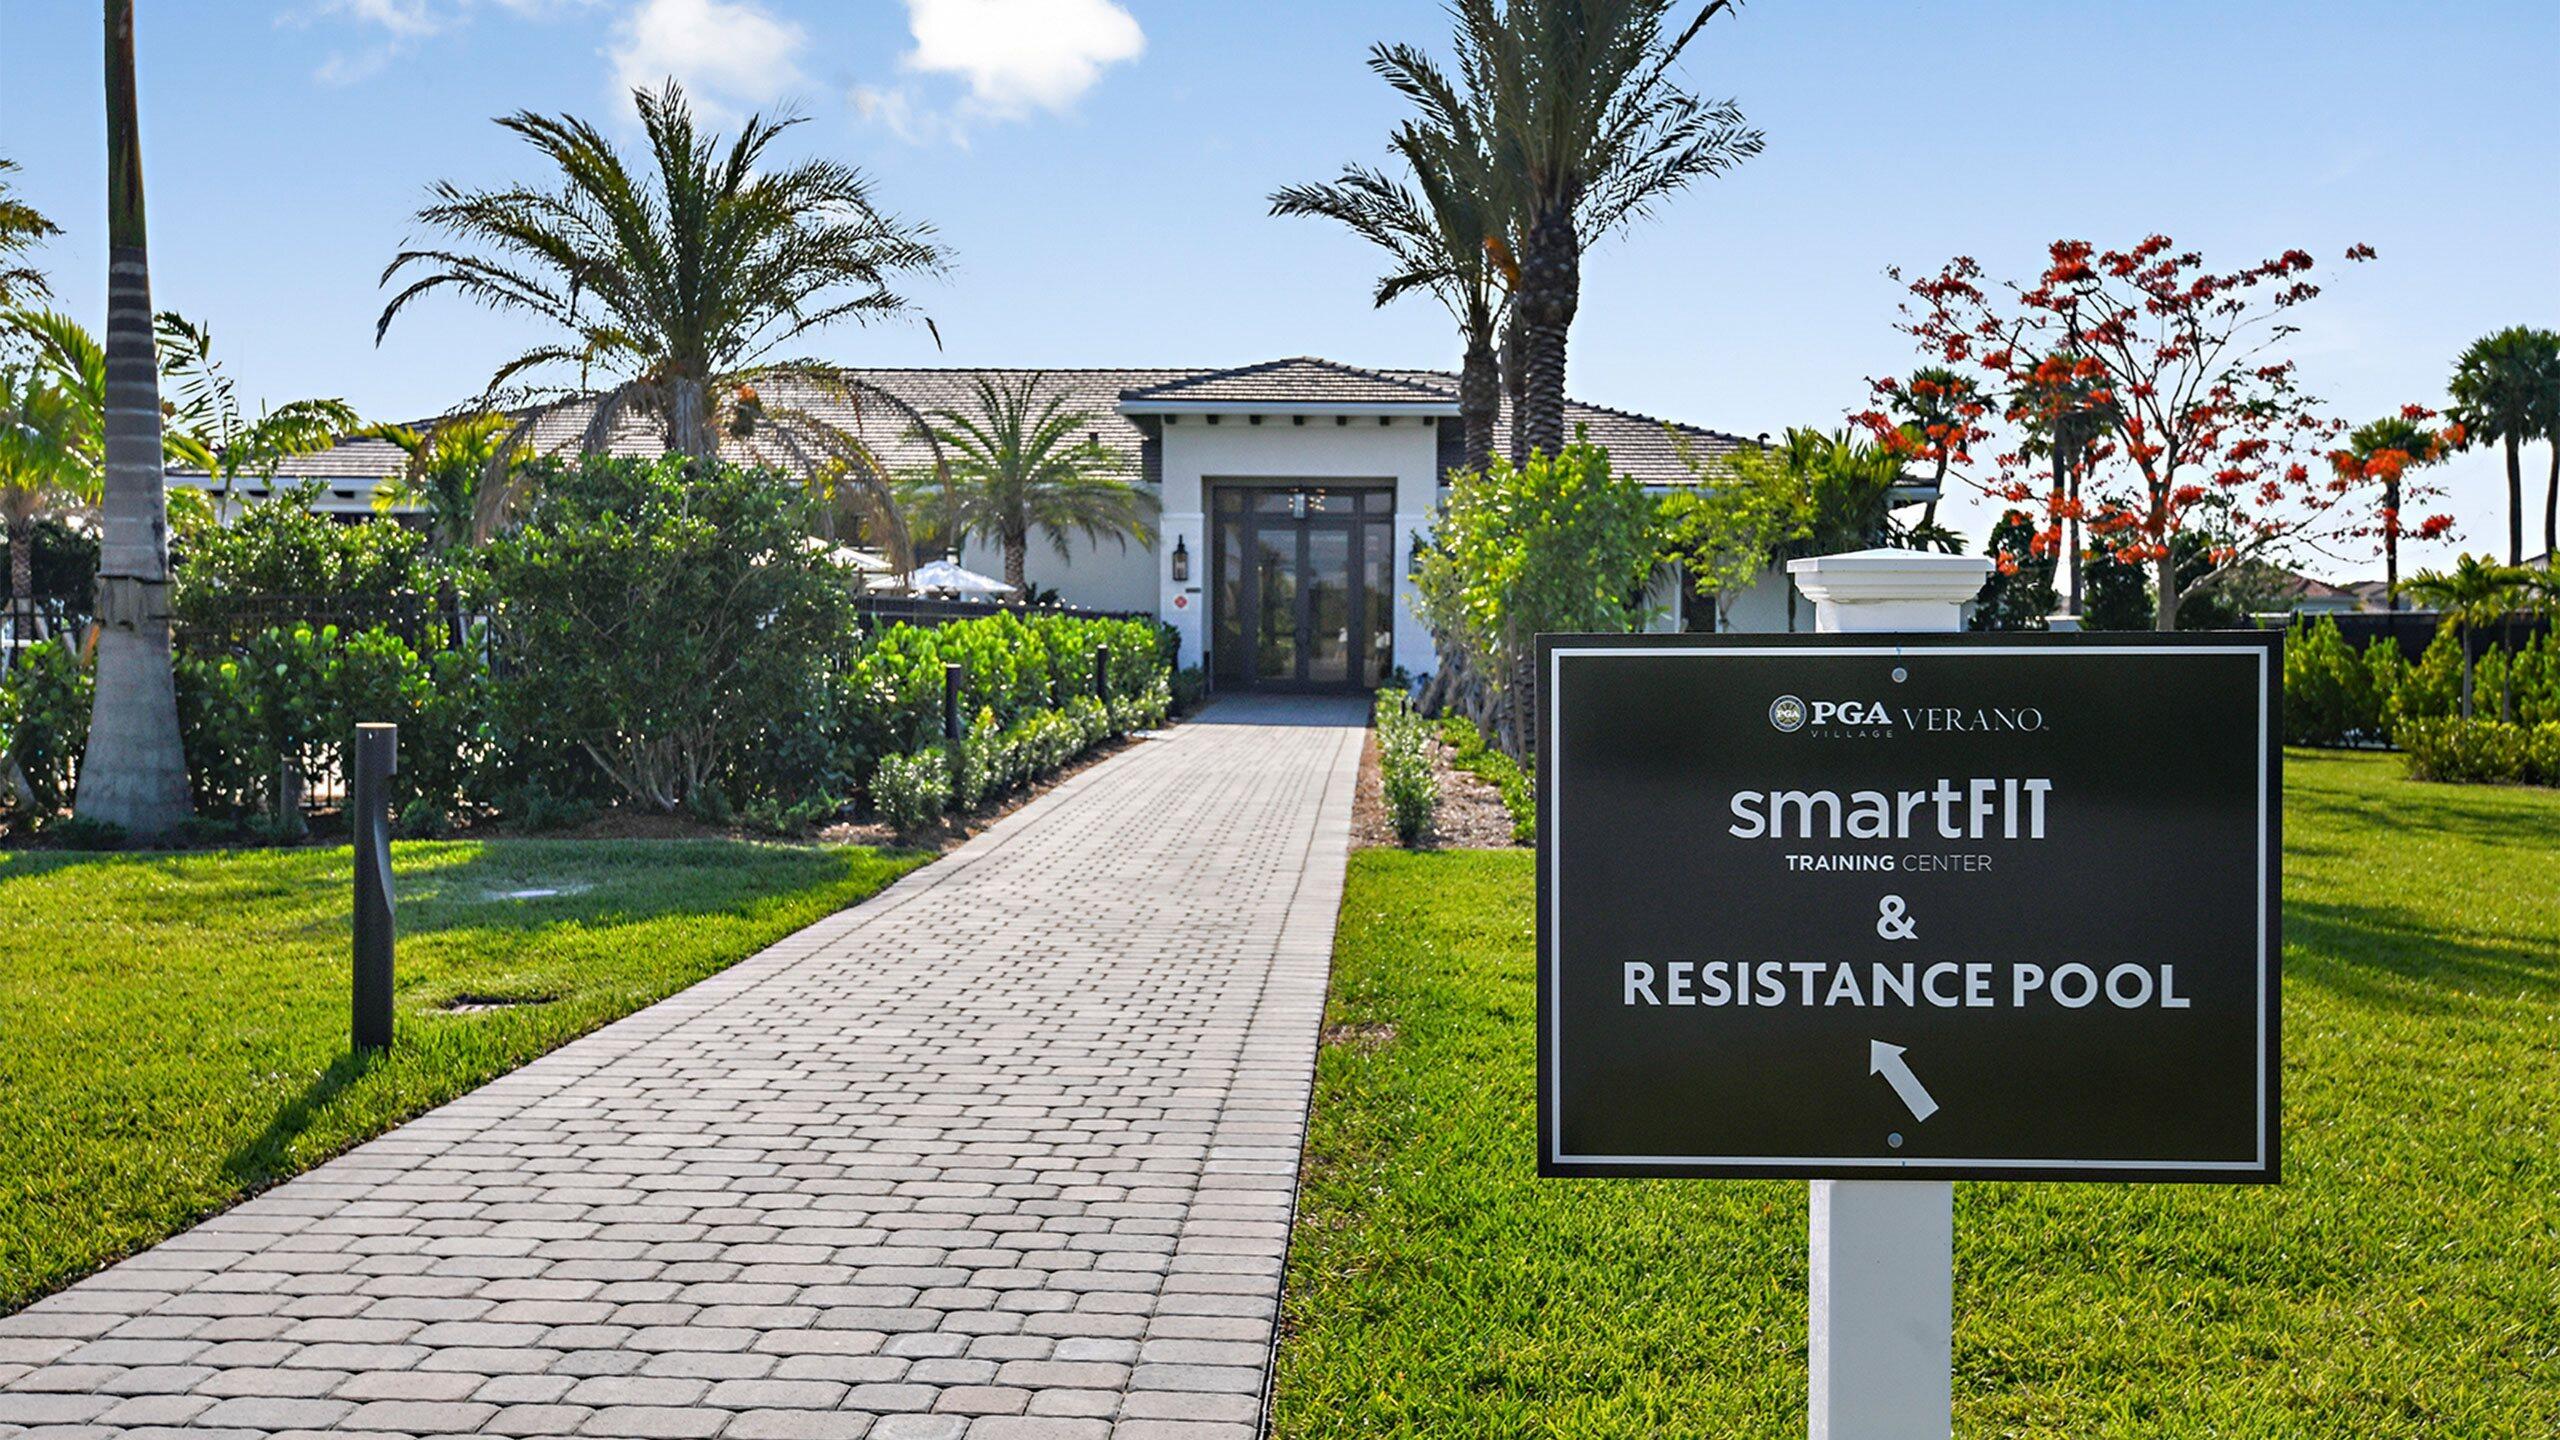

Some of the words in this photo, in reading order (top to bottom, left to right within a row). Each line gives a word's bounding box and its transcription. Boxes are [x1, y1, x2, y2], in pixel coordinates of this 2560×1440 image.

[1810, 701, 1893, 725] PGA
[1810, 729, 1893, 739] VILLAGE
[1728, 778, 2053, 839] smartFIT
[1785, 854, 1895, 872] TRAINING
[1902, 854, 1993, 872] CENTER
[1876, 894, 1919, 941] &
[1623, 960, 1995, 1008] RESISTANCE
[2012, 962, 2191, 1009] POOL
